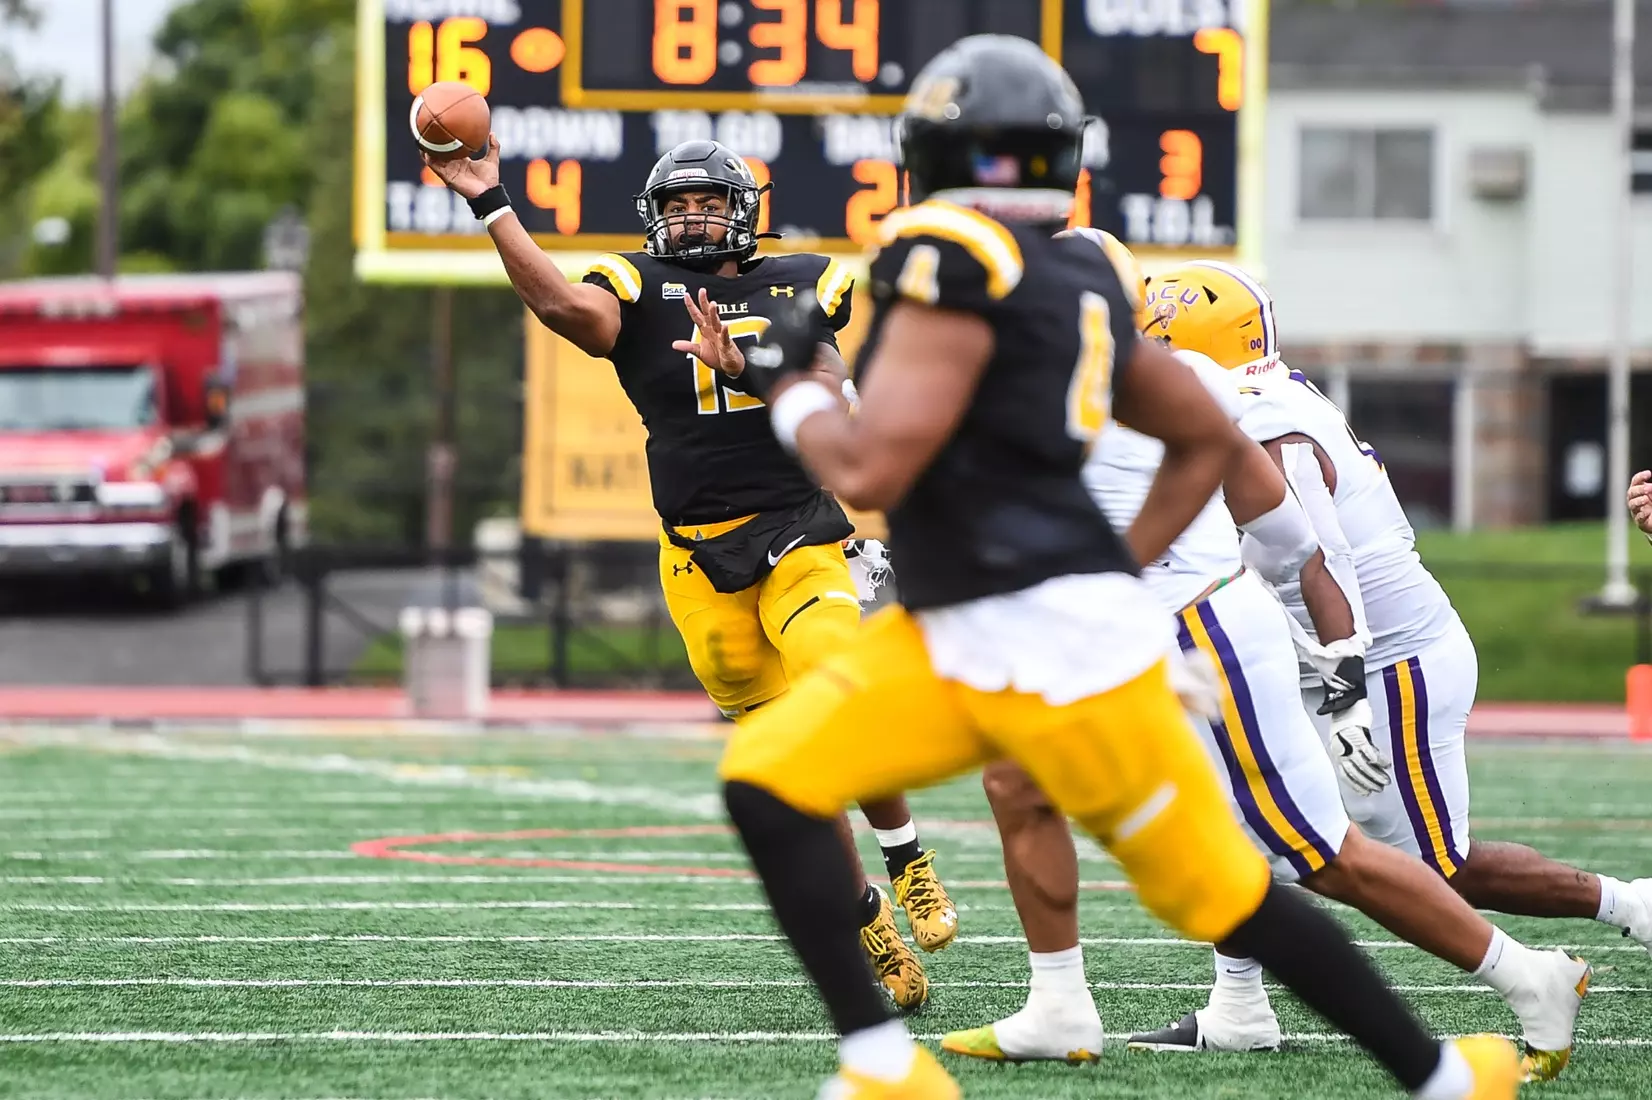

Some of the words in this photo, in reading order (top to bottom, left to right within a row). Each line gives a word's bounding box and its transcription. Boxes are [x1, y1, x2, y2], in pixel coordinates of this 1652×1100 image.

[408, 17, 491, 97] 16
[1194, 28, 1246, 111] 7
[527, 158, 582, 236] 4
[1159, 129, 1202, 200] 3
[717, 302, 749, 315] ILLE
[1249, 337, 1262, 350] 00
[1245, 359, 1279, 376] Ridd
